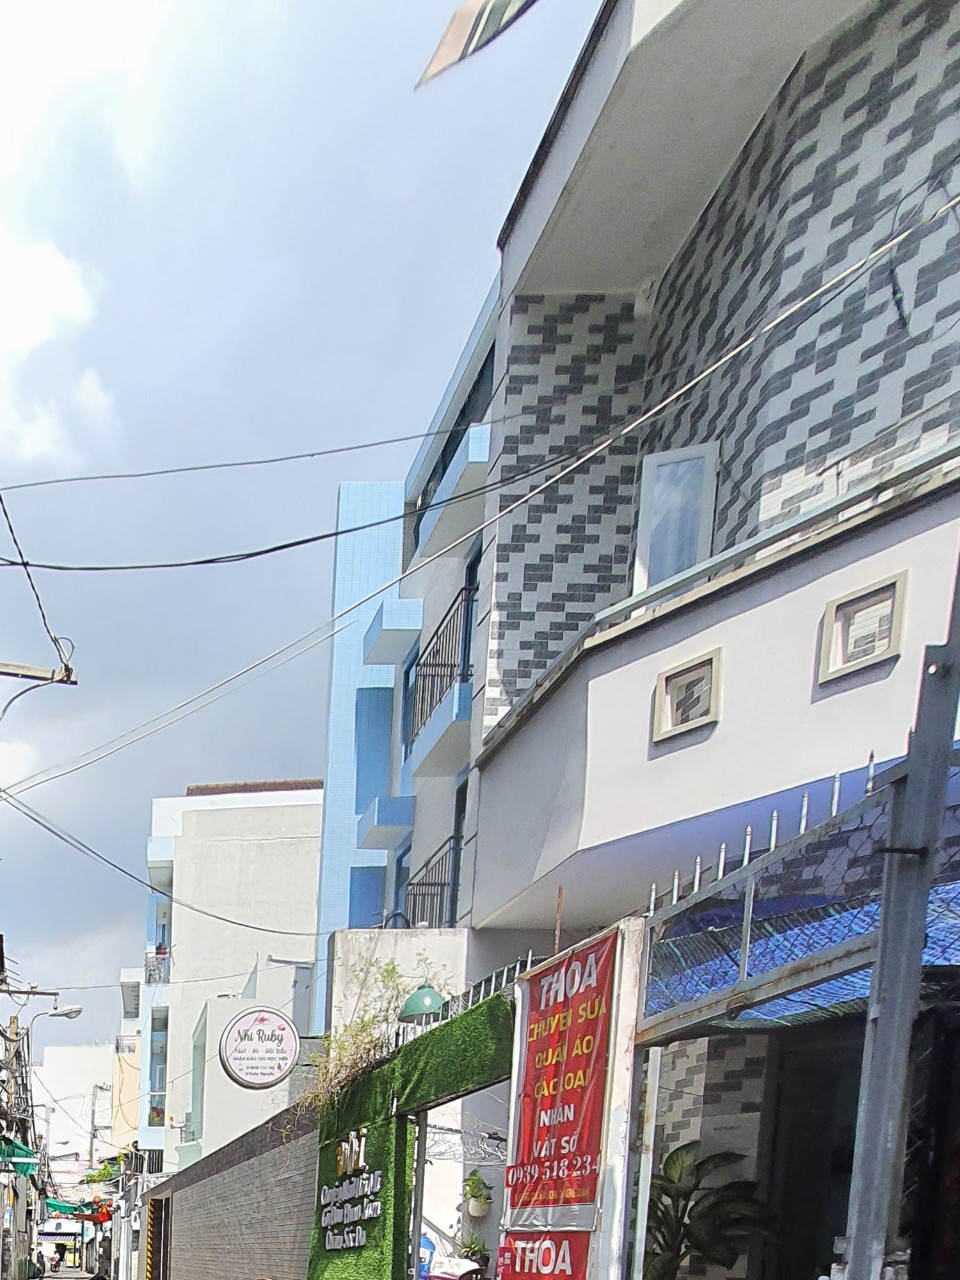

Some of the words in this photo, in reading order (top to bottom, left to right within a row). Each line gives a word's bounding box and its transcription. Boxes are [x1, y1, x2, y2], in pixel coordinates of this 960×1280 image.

[540, 952, 597, 1010] THOA
[528, 1008, 573, 1042] CHUYÊN
[578, 993, 607, 1024] SỬA
[234, 1029, 254, 1042] Nhi
[256, 1029, 284, 1047] Ruby
[572, 1033, 594, 1057] ÁO
[535, 1075, 558, 1098] CÁC
[508, 1164, 539, 1186] 0939
[542, 1158, 568, 1181] 518
[514, 1240, 572, 1275] THOA
